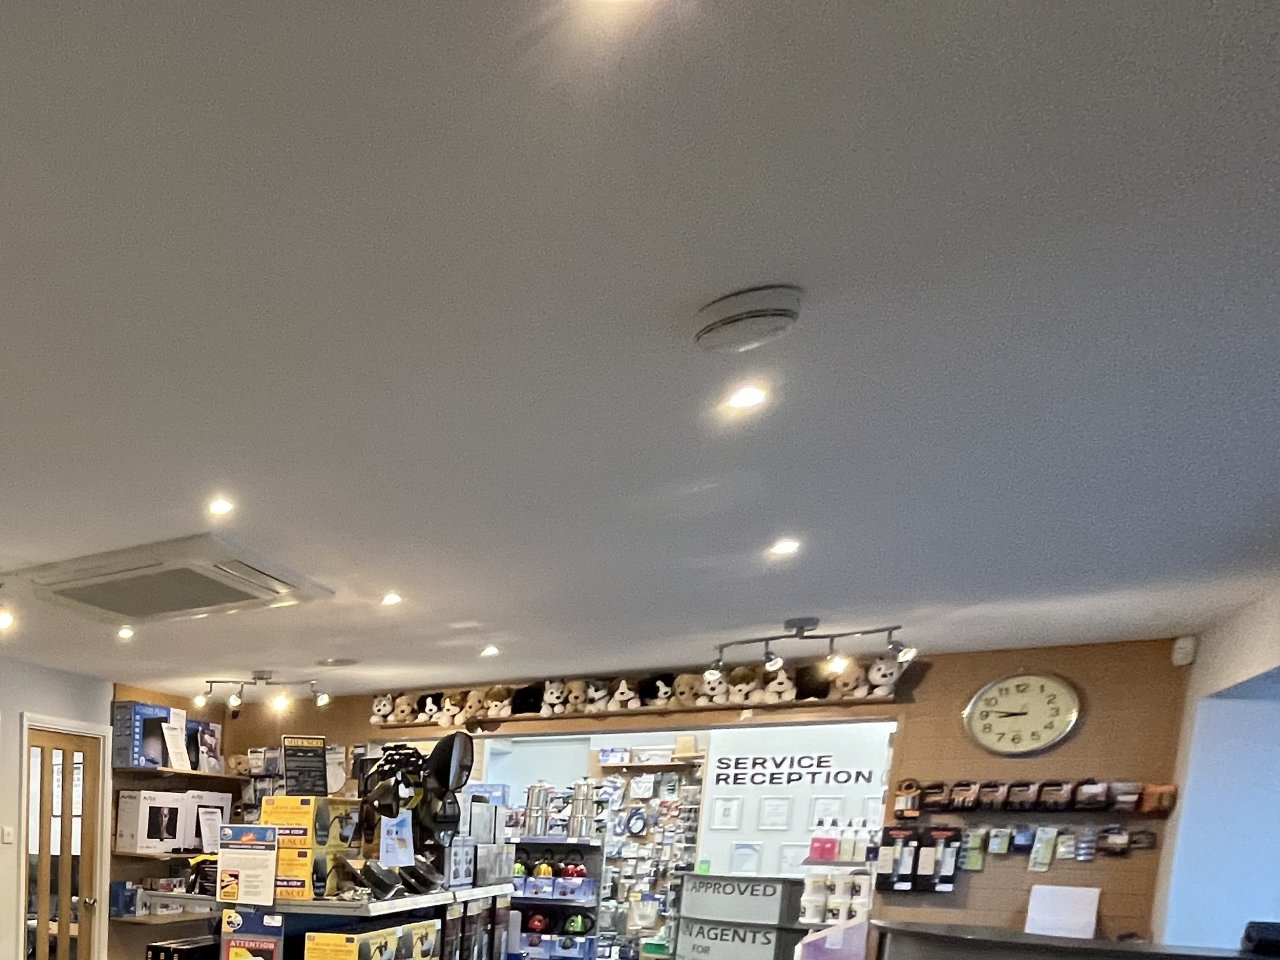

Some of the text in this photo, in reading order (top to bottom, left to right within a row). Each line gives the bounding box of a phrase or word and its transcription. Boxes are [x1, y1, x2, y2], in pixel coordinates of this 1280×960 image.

[999, 687, 1009, 697] 11
[1015, 683, 1030, 693] 12
[1040, 684, 1045, 693] 1
[984, 697, 998, 707] 10
[1047, 693, 1057, 705] 2
[980, 710, 989, 720] 9
[1049, 706, 1060, 718] 3
[982, 723, 992, 733] 8
[1044, 721, 1054, 730] 4
[996, 732, 1006, 742] 7
[1011, 734, 1022, 744] 6
[1031, 731, 1040, 740] 5
[286, 739, 324, 747] MILENCO
[716, 754, 833, 770] SERVICE
[715, 770, 874, 786] RECEPTION
[281, 838, 307, 846] ENCO
[280, 889, 305, 897] ENCO
[690, 881, 778, 897] APPROVED
[695, 925, 772, 945] AGENTS
[230, 940, 274, 949] ATTENTION
[692, 944, 711, 955] FOR
